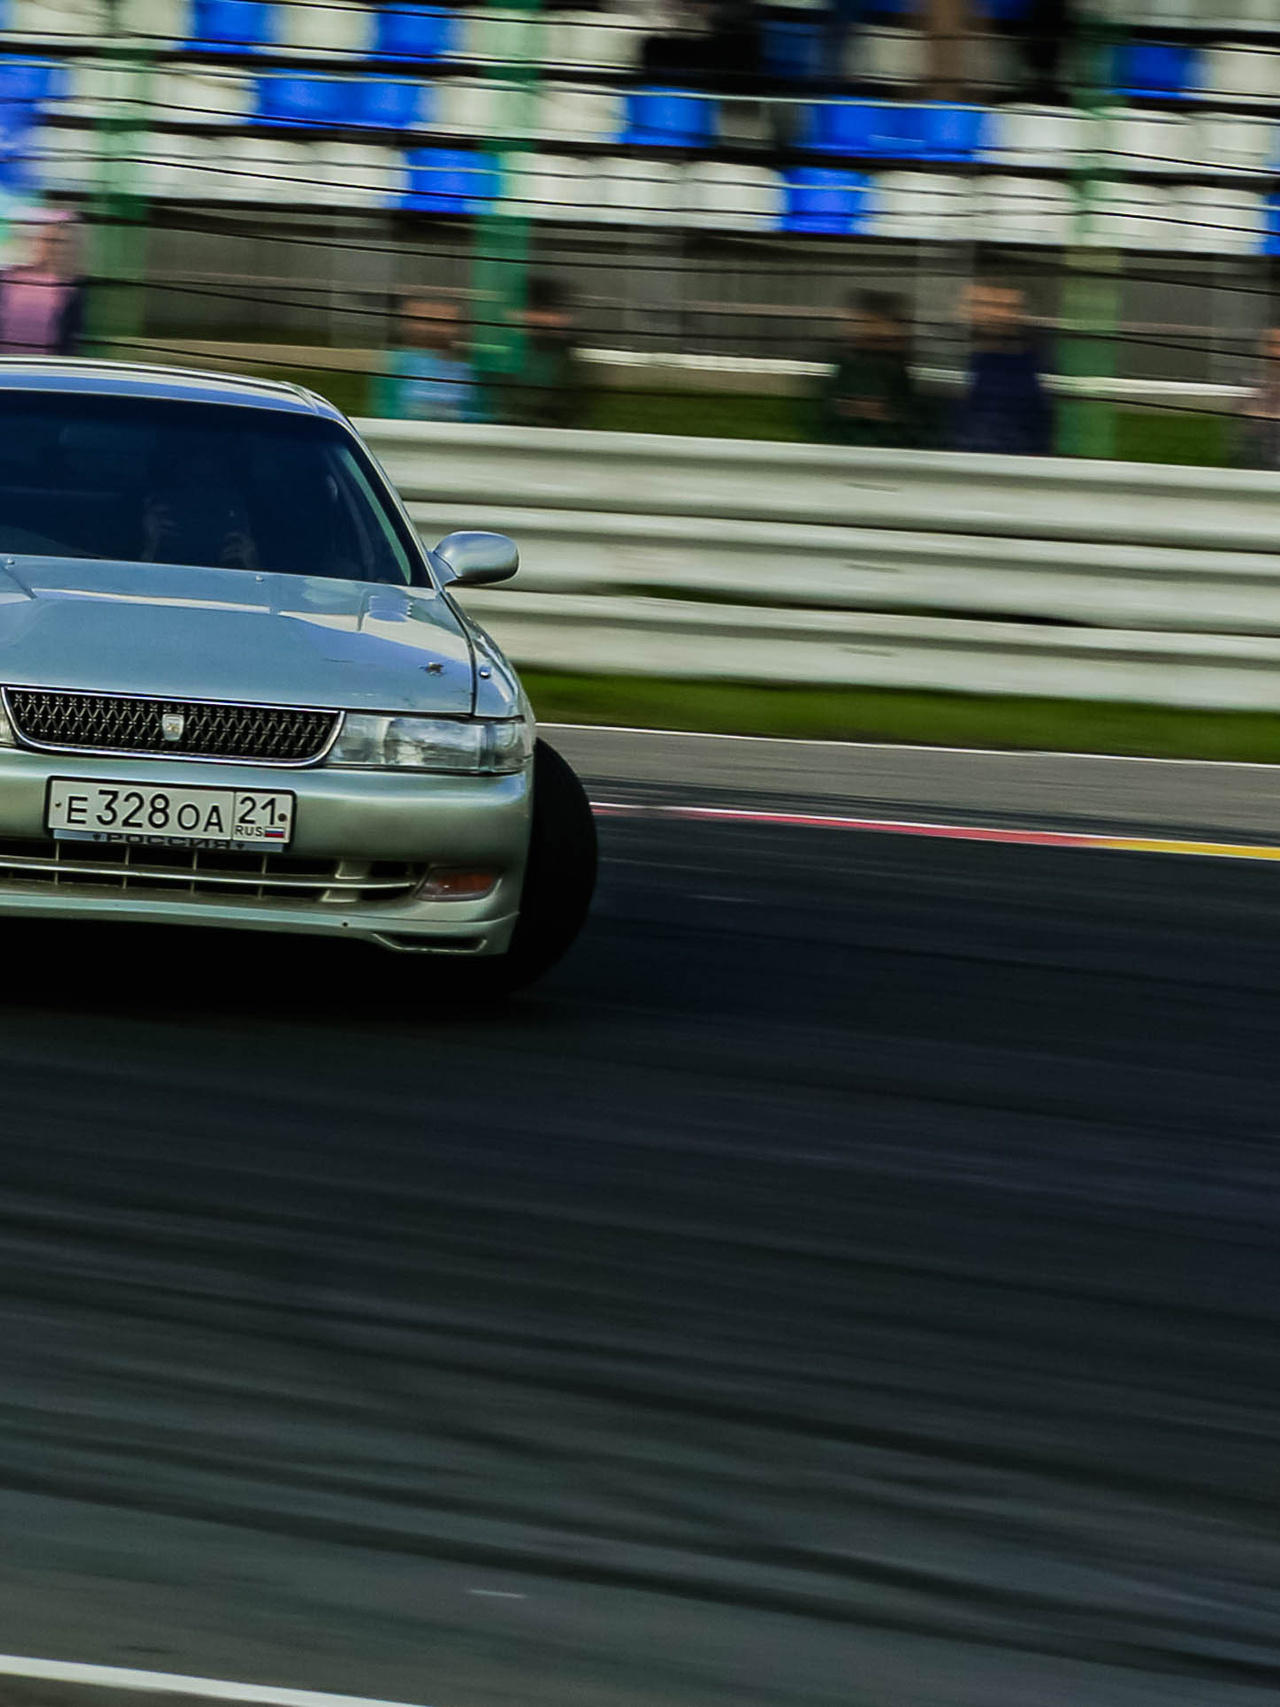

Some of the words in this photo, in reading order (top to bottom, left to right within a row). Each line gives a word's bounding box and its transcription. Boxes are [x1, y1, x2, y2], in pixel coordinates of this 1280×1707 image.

[66, 789, 224, 833] E328OA
[238, 796, 276, 825] 21
[235, 825, 263, 837] RUS
